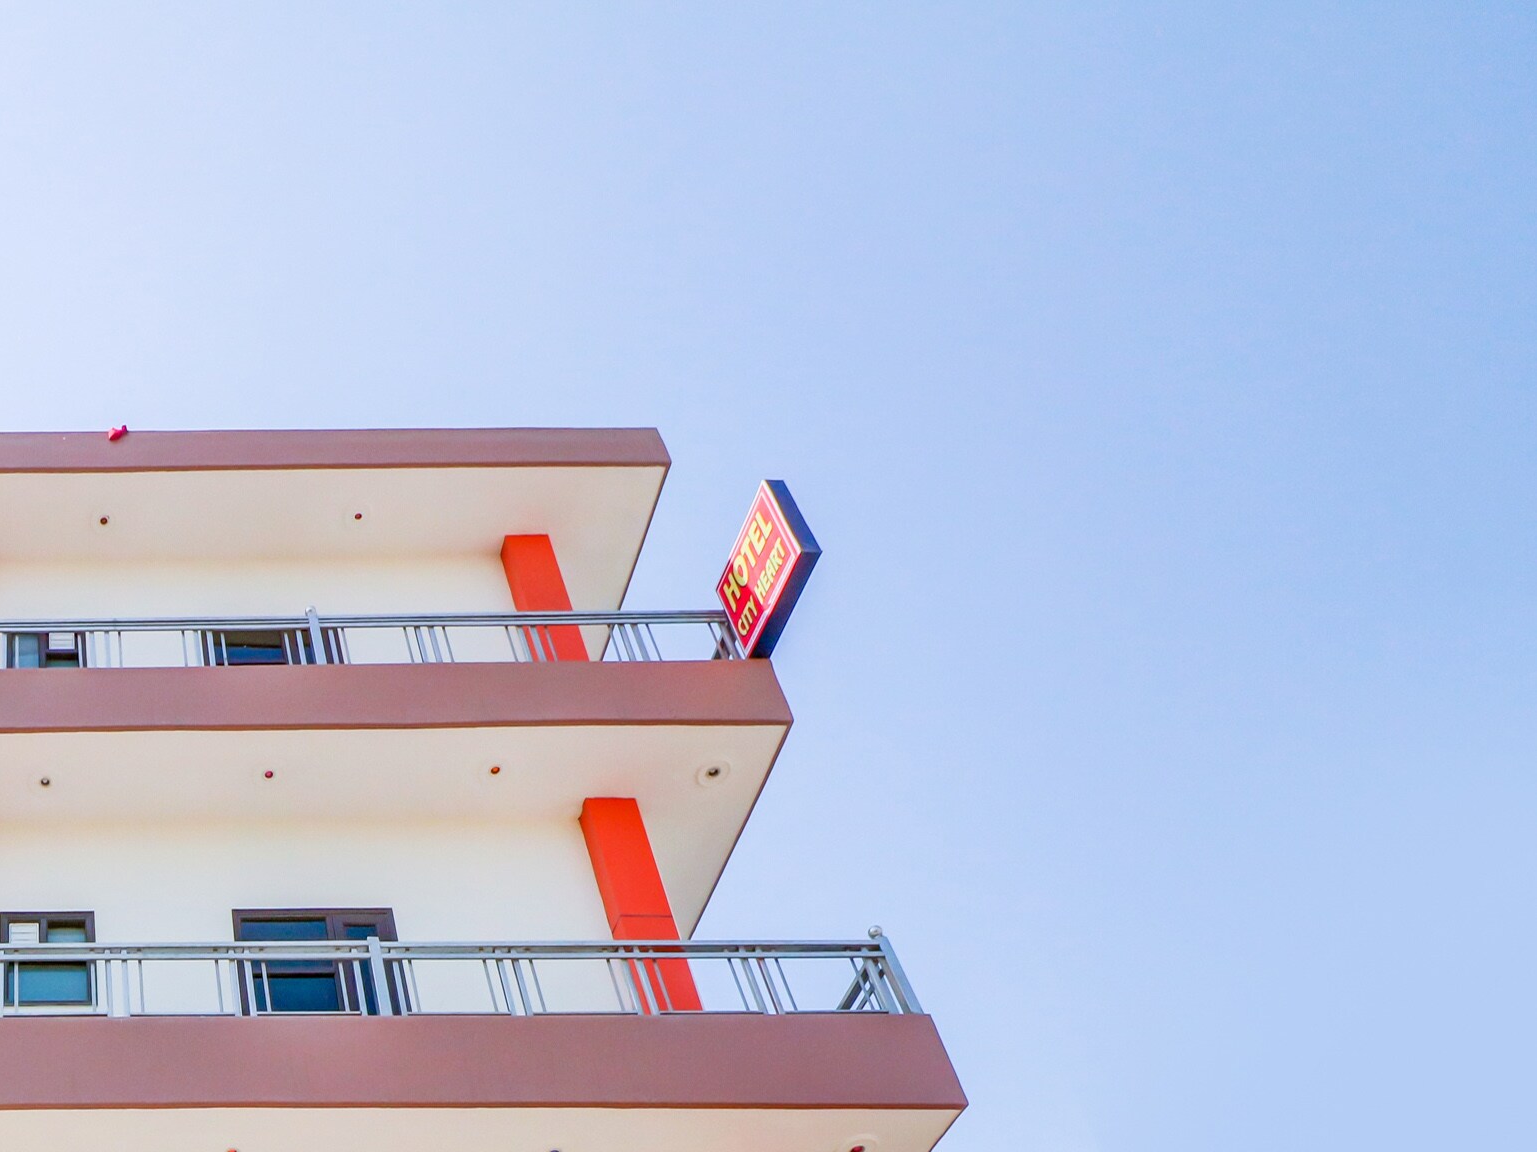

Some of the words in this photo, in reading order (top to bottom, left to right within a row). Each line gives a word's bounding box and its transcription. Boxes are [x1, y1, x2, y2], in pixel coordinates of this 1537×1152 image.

[722, 511, 773, 613] HOTEL
[737, 596, 758, 636] CITY
[754, 537, 786, 605] HEART
